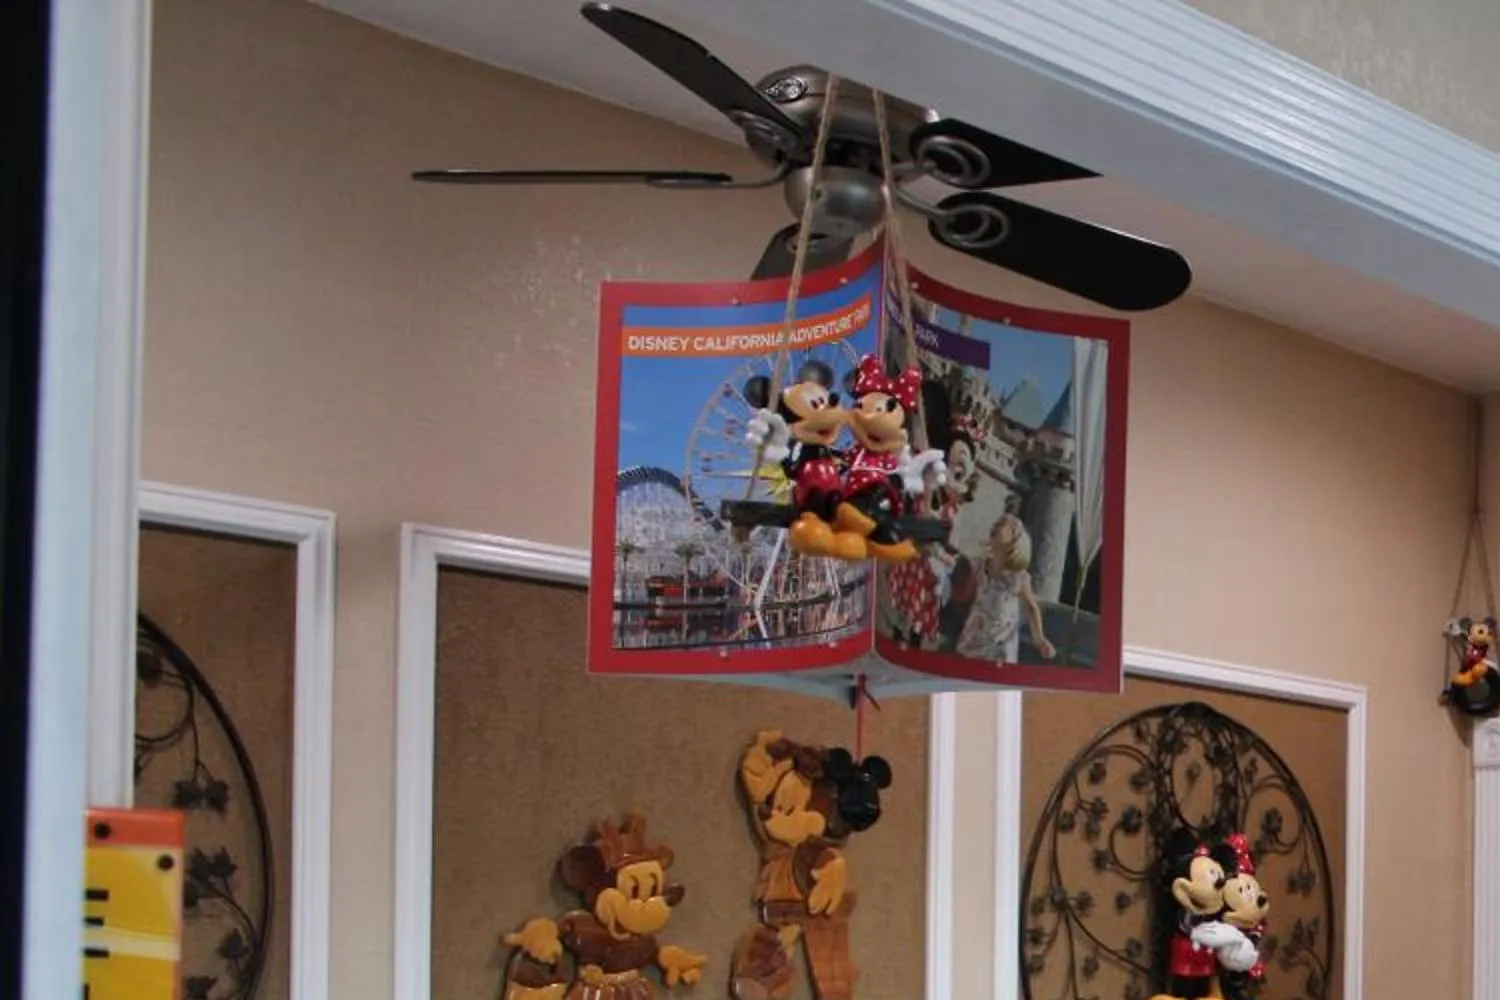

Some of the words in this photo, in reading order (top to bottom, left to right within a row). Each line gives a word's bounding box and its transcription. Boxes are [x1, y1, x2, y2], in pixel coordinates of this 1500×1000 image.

[627, 335, 689, 352] DISNEY
[693, 333, 783, 351] CALIFORNIA
[788, 315, 853, 343] ADVENTURE
